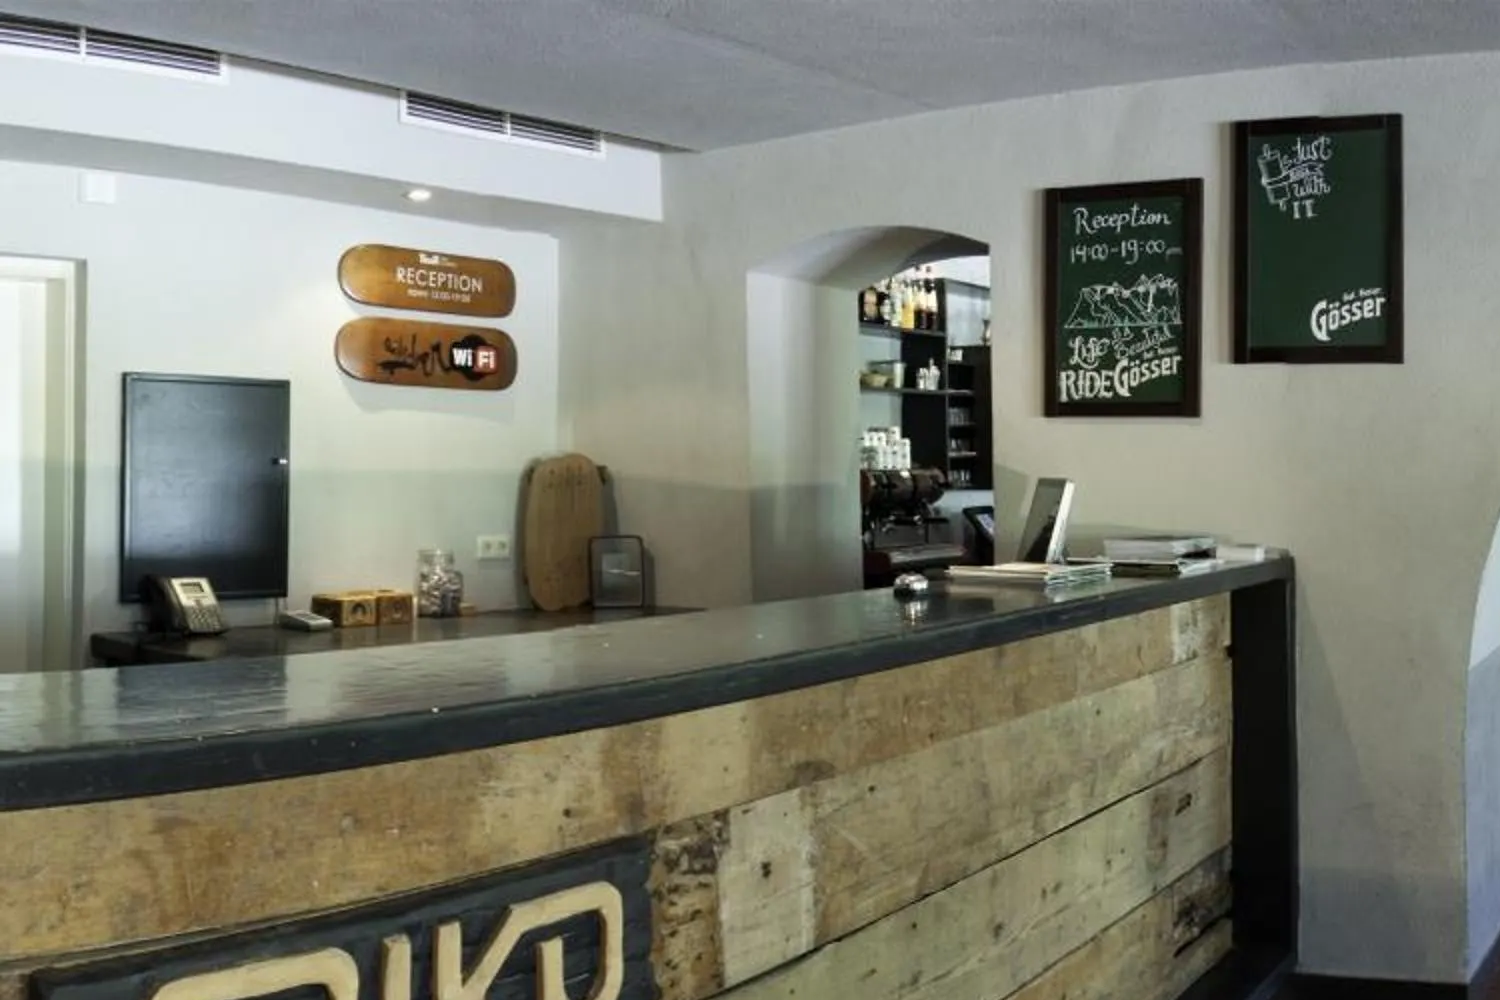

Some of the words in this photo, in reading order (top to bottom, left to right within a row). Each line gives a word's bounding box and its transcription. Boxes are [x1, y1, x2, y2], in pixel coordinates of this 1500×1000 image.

[1072, 203, 1171, 235] Reception
[396, 266, 483, 293] RECEPTION
[1310, 297, 1386, 341] Gösser
[1059, 369, 1114, 403] RIDE
[1113, 355, 1182, 397] Gösser
